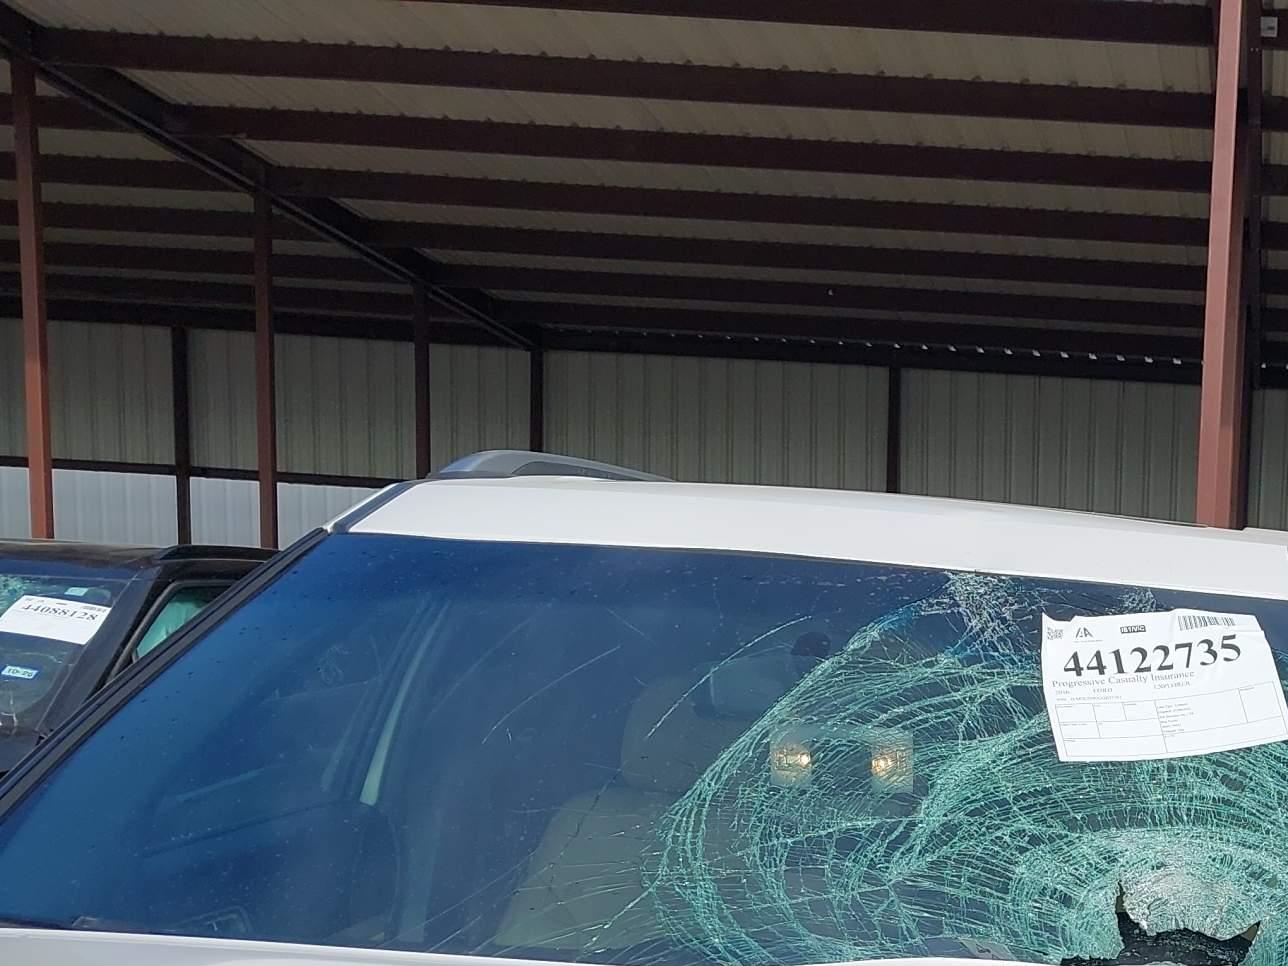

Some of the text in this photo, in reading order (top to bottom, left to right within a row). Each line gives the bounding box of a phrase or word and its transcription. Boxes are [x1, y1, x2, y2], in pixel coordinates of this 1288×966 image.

[1063, 633, 1242, 677] 44122735
[1052, 671, 1196, 689] Progressive Casualty Insurance
